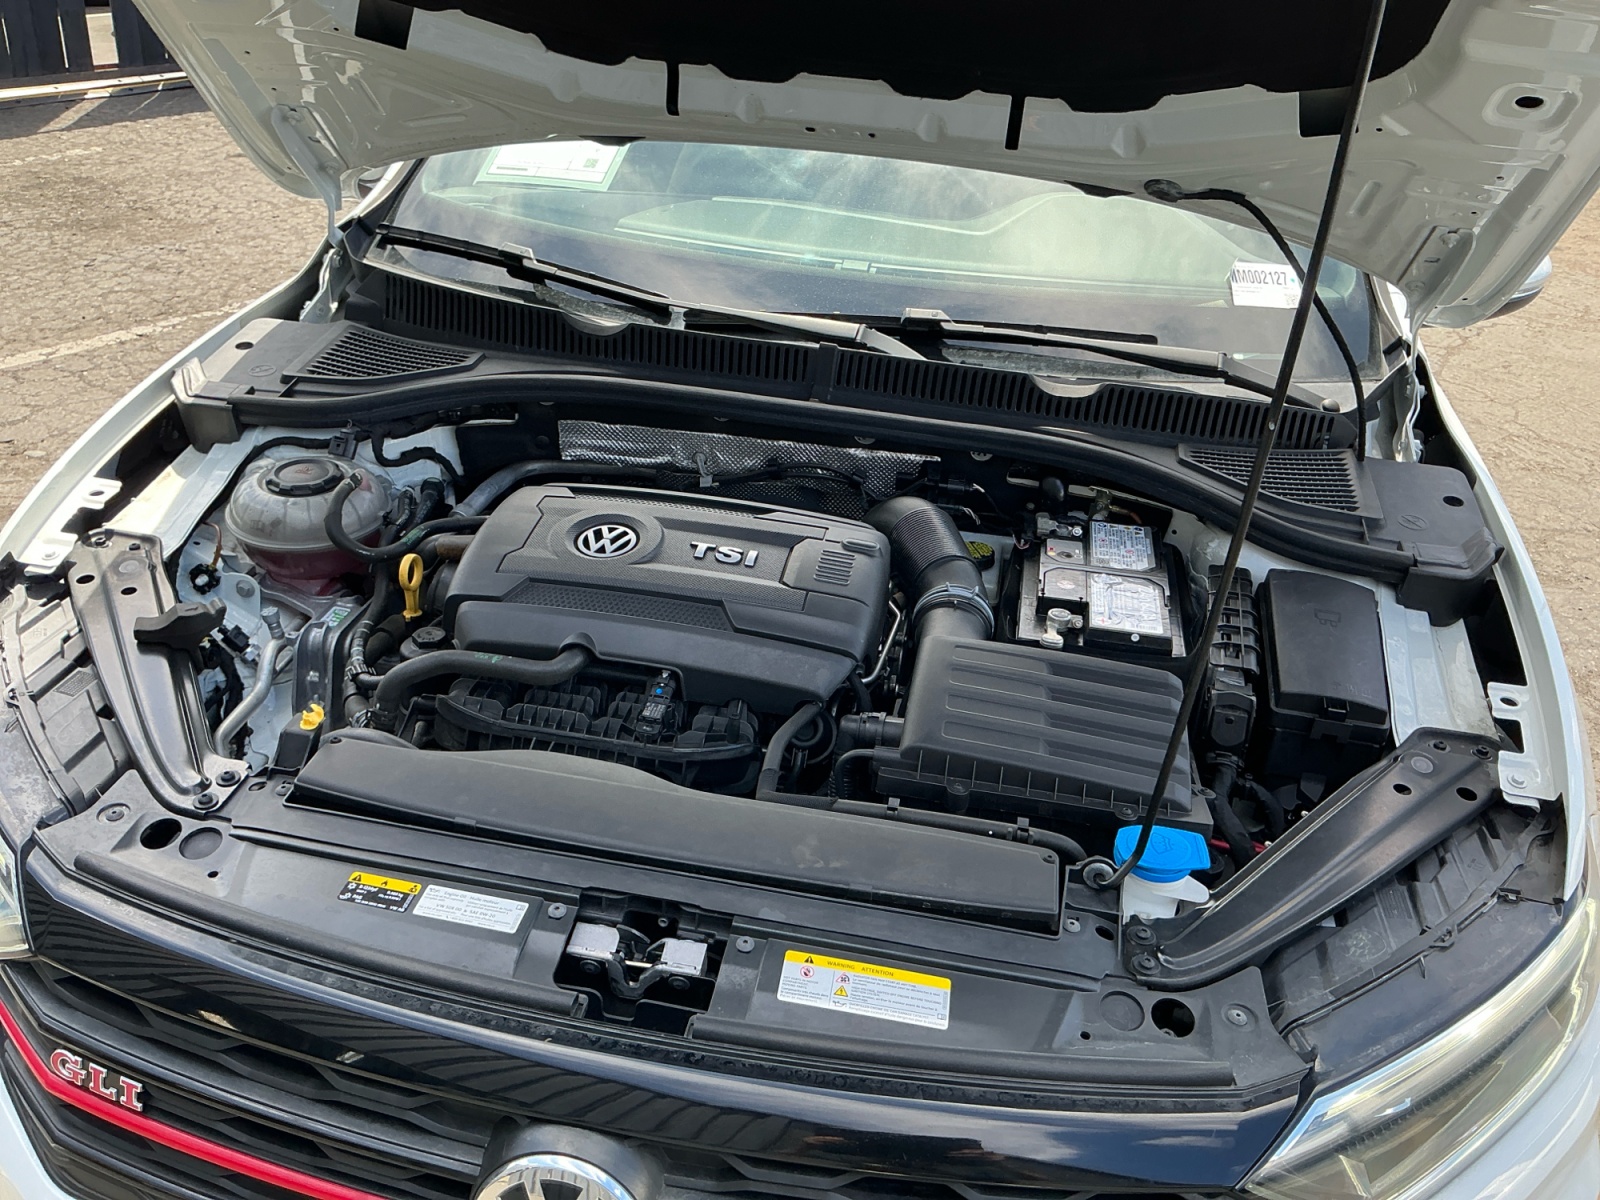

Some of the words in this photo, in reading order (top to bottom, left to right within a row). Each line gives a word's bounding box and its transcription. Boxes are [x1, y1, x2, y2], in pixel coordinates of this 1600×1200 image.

[690, 541, 759, 567] TSI
[826, 960, 856, 970] WARNING
[861, 966, 894, 977] ATTENTION
[50, 1048, 144, 1112] GLI
